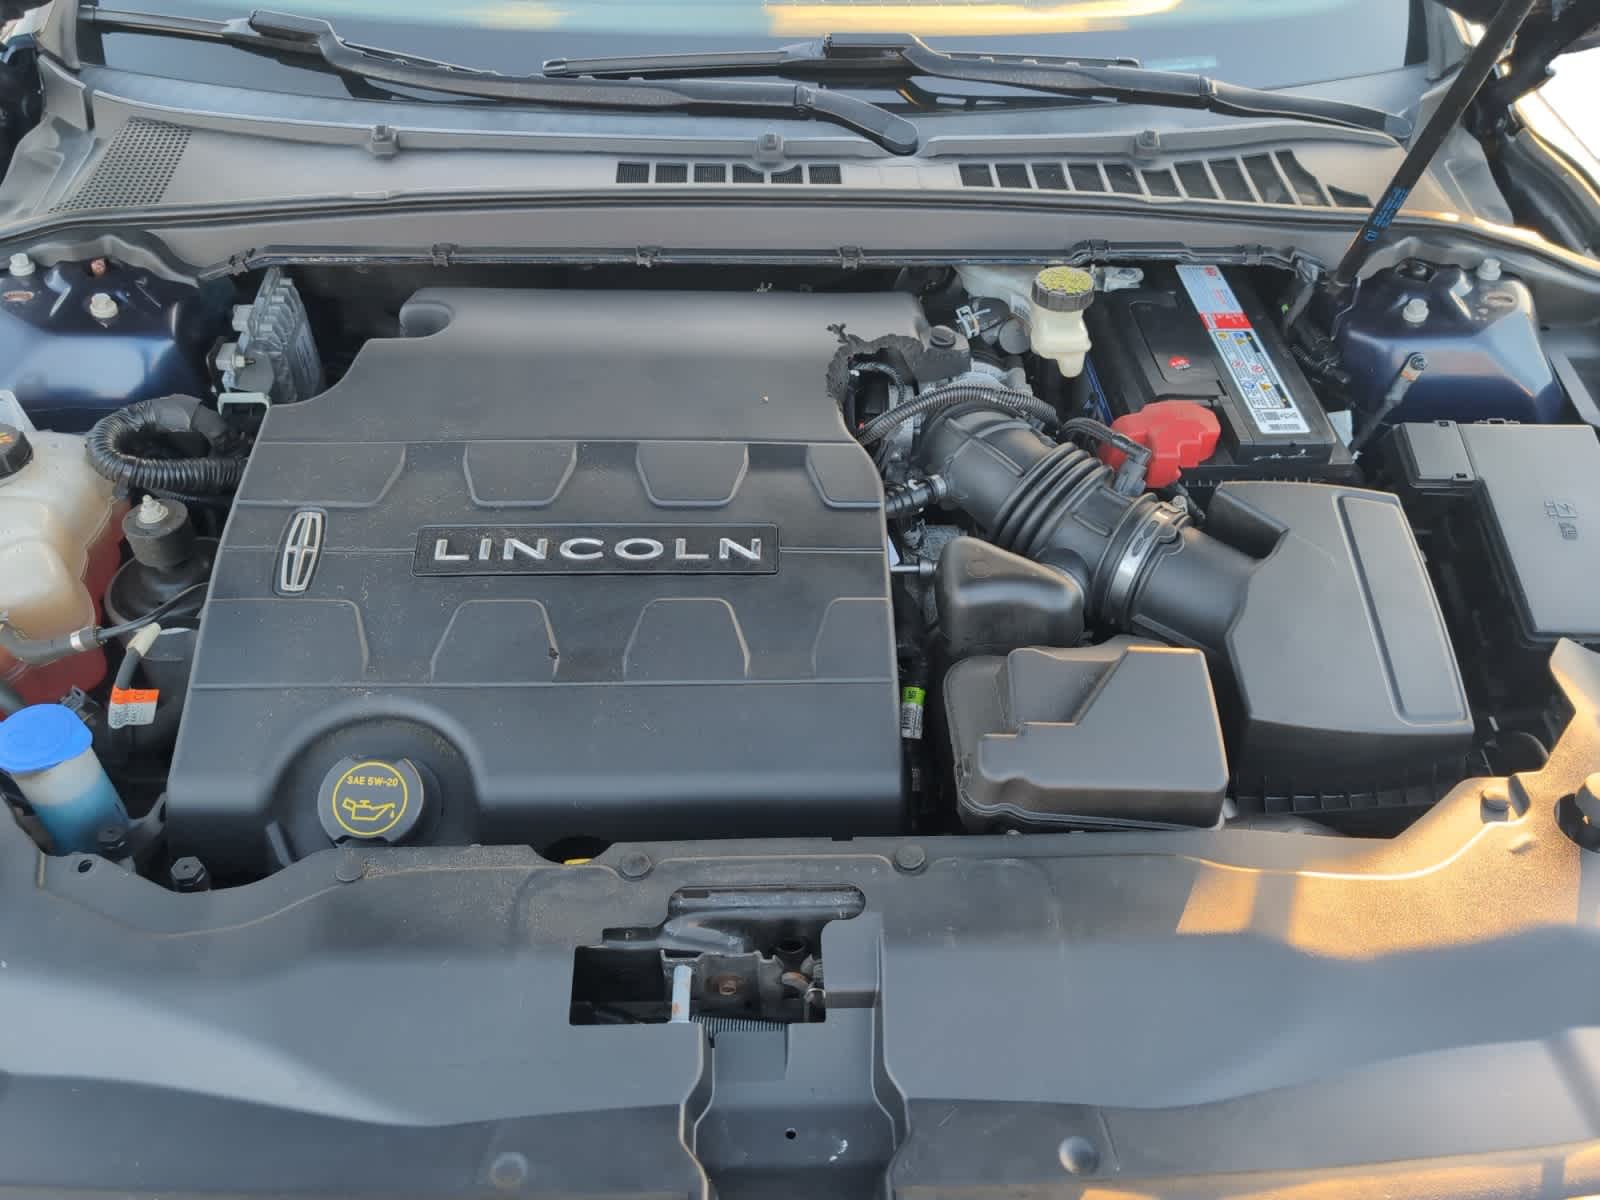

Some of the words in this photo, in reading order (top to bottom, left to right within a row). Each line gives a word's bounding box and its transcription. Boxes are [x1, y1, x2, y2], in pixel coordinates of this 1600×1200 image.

[434, 537, 762, 561] LINCOLN
[347, 775, 366, 785] SAE
[368, 776, 399, 786] 5W-20
